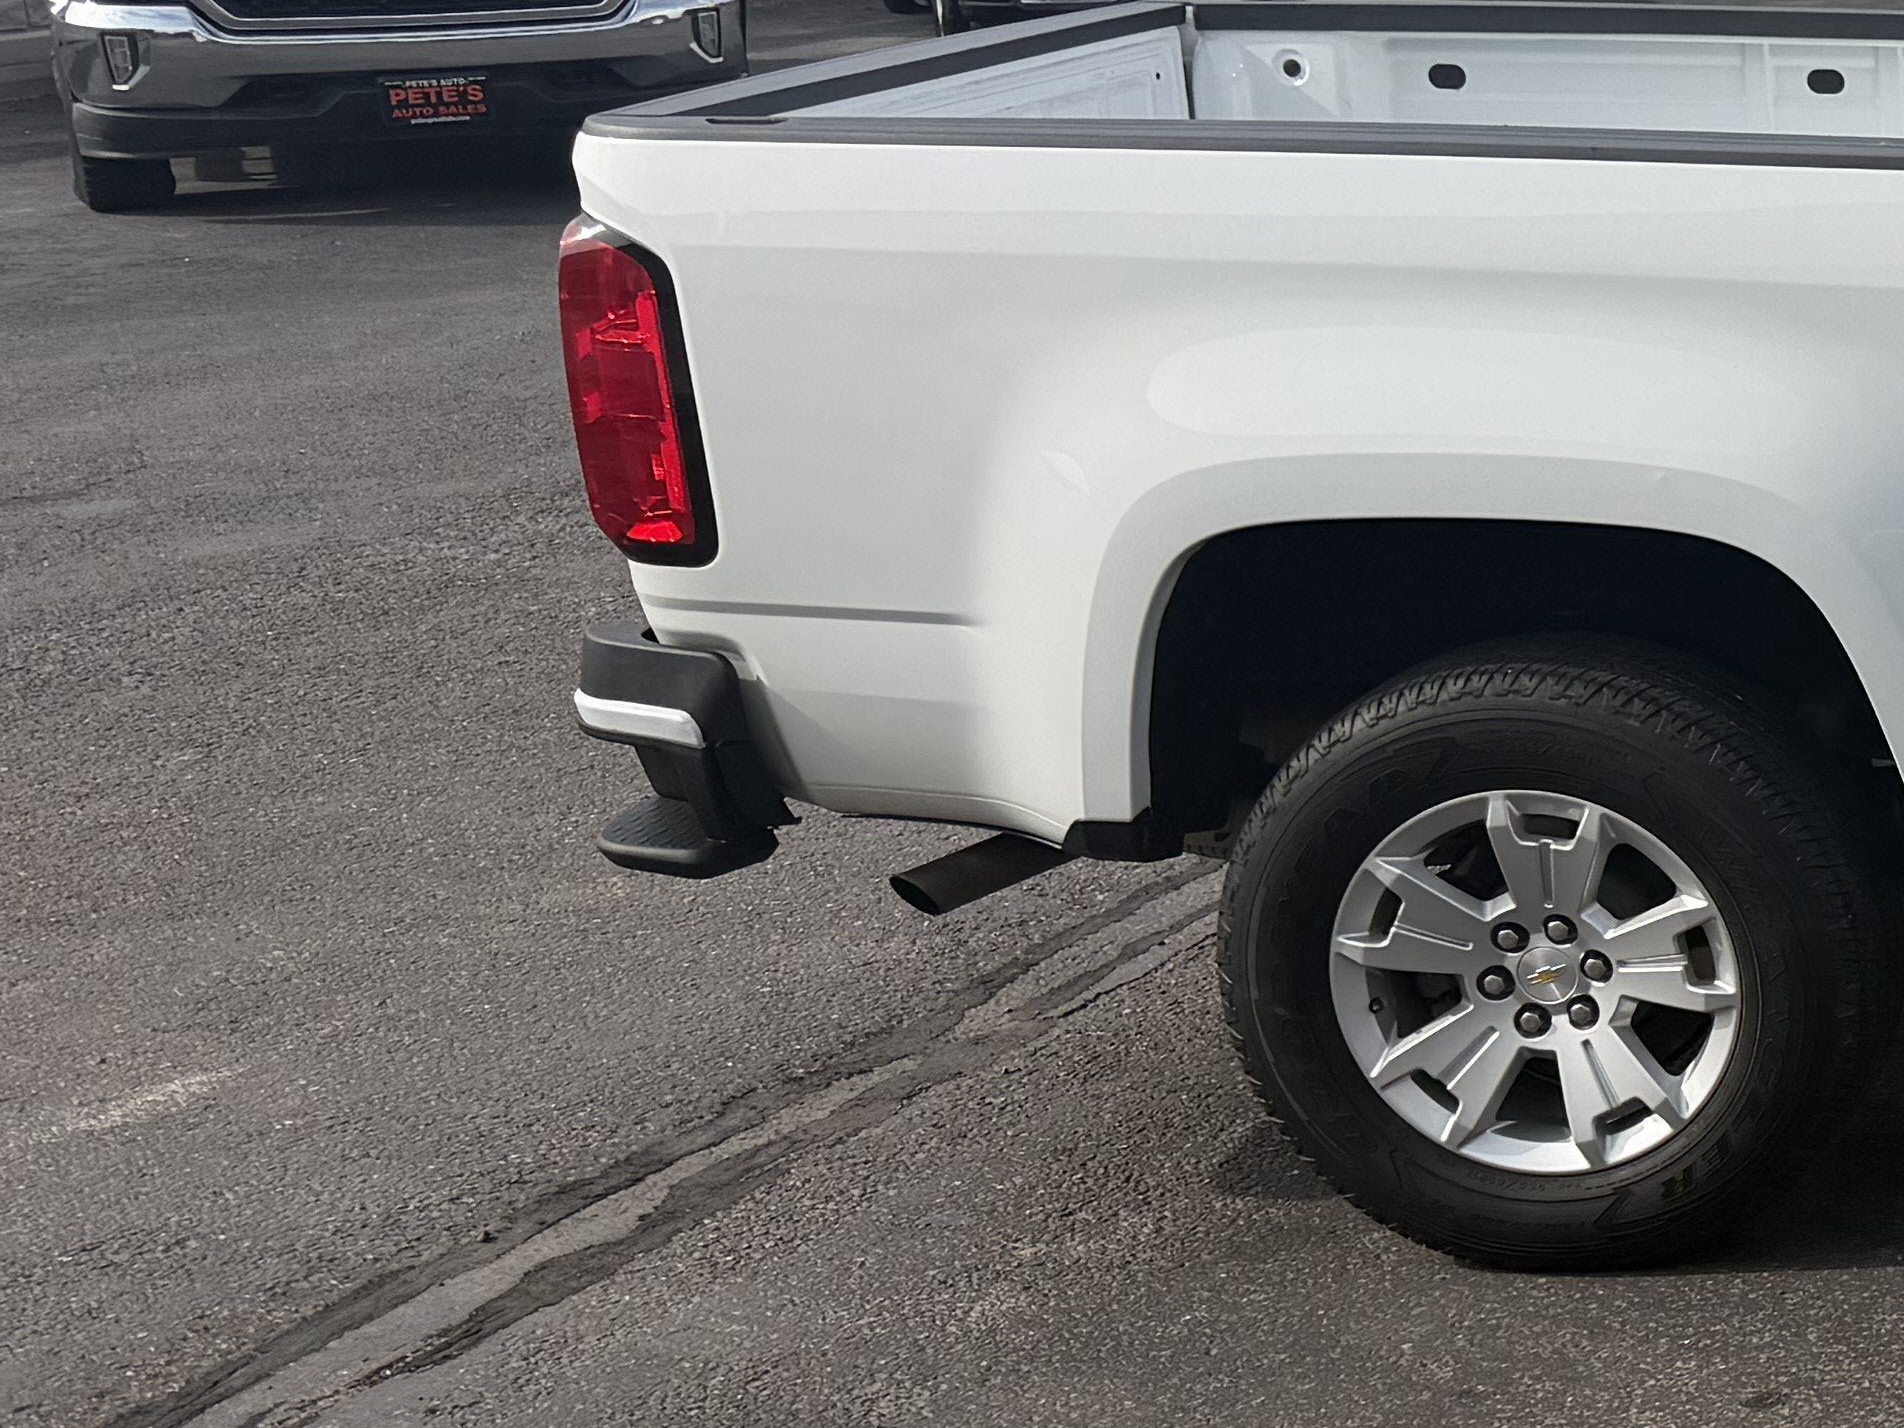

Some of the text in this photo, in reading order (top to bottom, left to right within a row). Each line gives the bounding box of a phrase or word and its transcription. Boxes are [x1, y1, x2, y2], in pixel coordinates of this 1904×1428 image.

[389, 85, 485, 105] PETE'S
[392, 104, 487, 118] AUTO SALES
